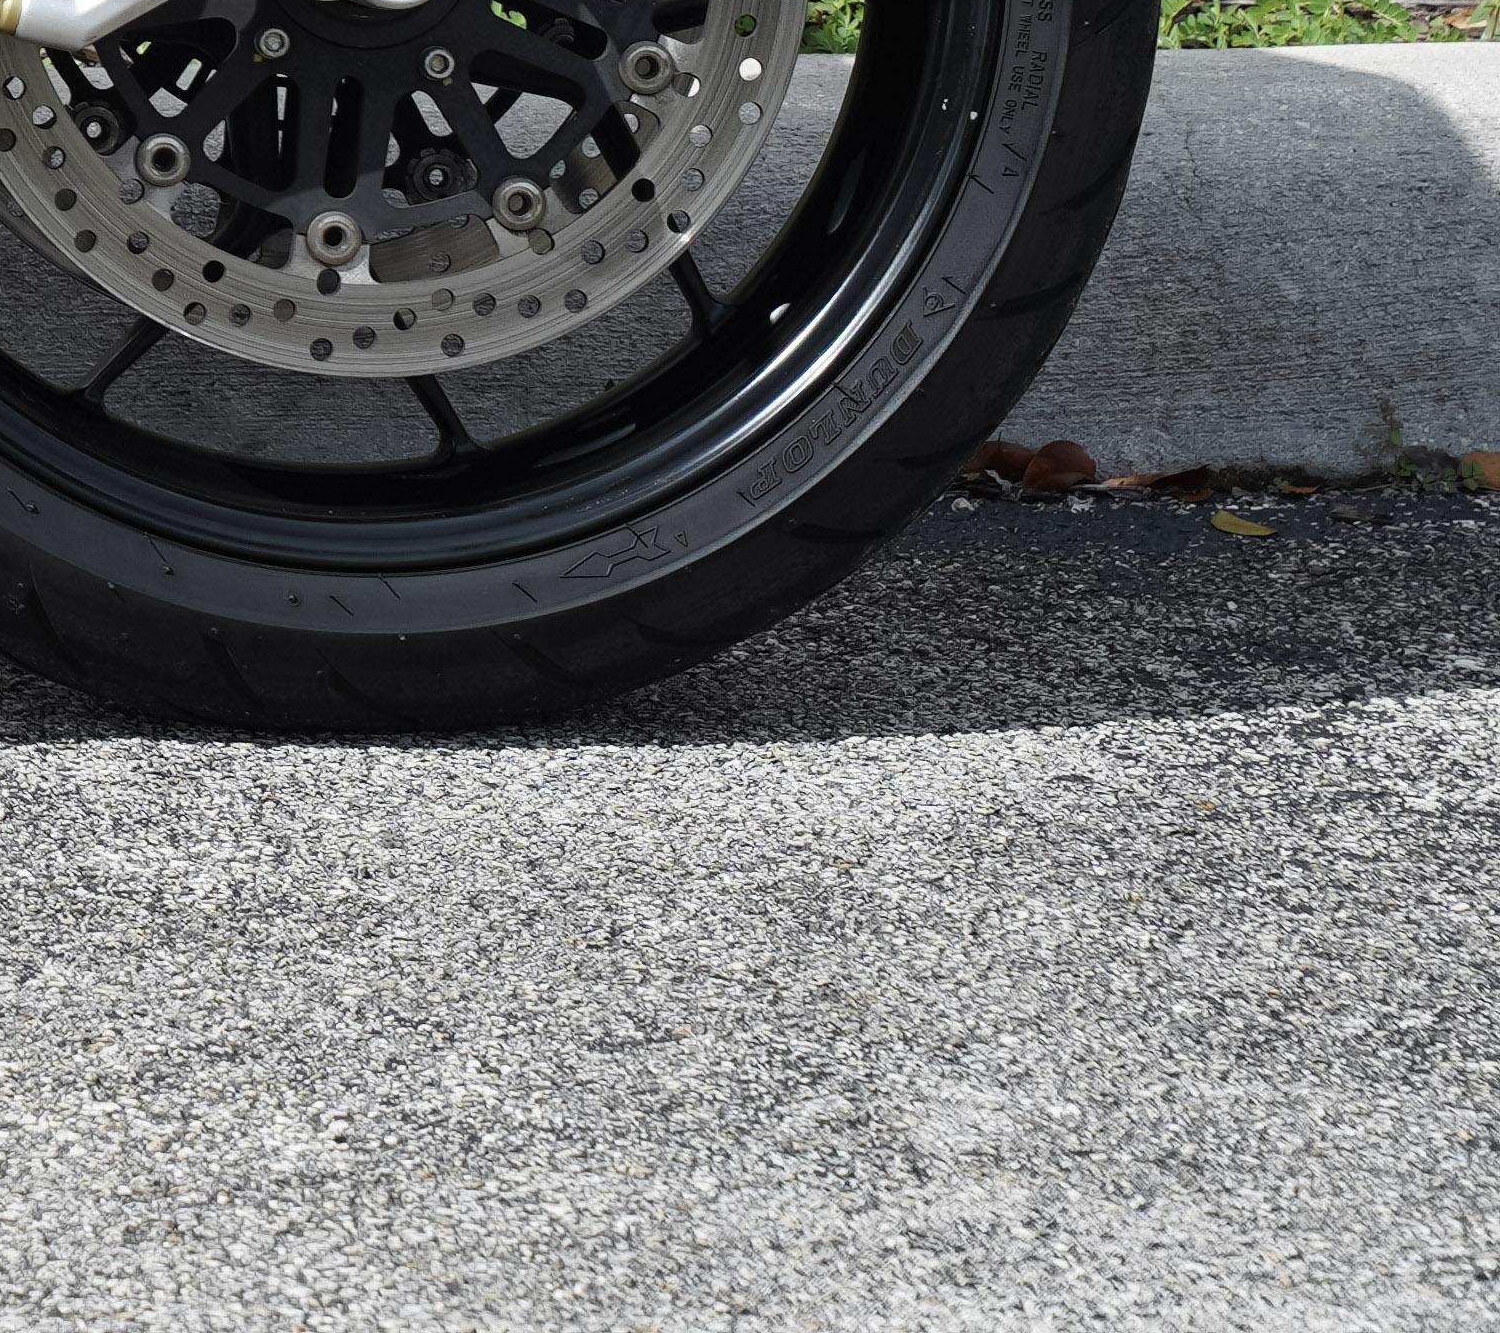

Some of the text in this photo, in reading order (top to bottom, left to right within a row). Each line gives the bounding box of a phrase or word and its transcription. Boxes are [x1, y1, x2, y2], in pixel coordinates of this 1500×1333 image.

[1013, 13, 1033, 58] WHEEL
[1006, 64, 1025, 93] USE
[1019, 50, 1048, 113] RADIAL
[995, 98, 1018, 135] ONLY
[750, 322, 924, 499] DUNLOP
